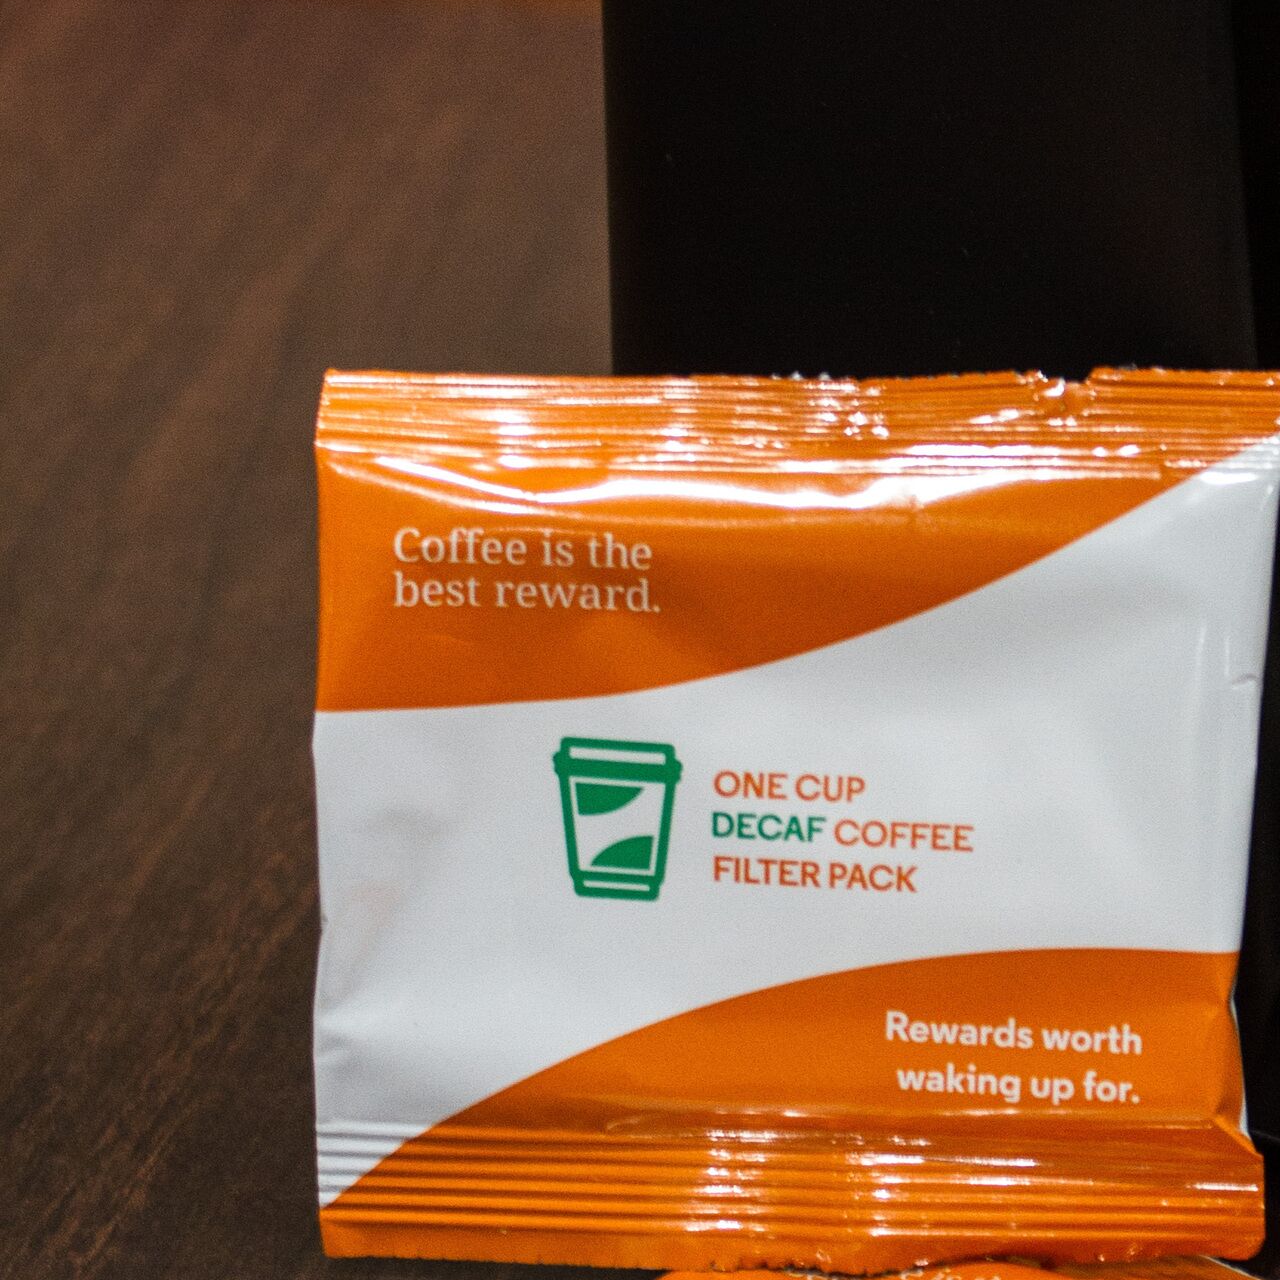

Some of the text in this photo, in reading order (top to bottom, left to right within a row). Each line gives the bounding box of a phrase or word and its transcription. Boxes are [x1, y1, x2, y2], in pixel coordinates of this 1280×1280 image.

[393, 526, 653, 570] Coffee is the
[393, 570, 662, 613] best reward.
[712, 770, 867, 803] ONE CUP
[710, 810, 975, 852] DECAF COFFEE
[712, 854, 919, 894] FILTER PACK
[885, 1009, 1143, 1055] Rewards worth
[896, 1061, 1141, 1106] waking up for.
